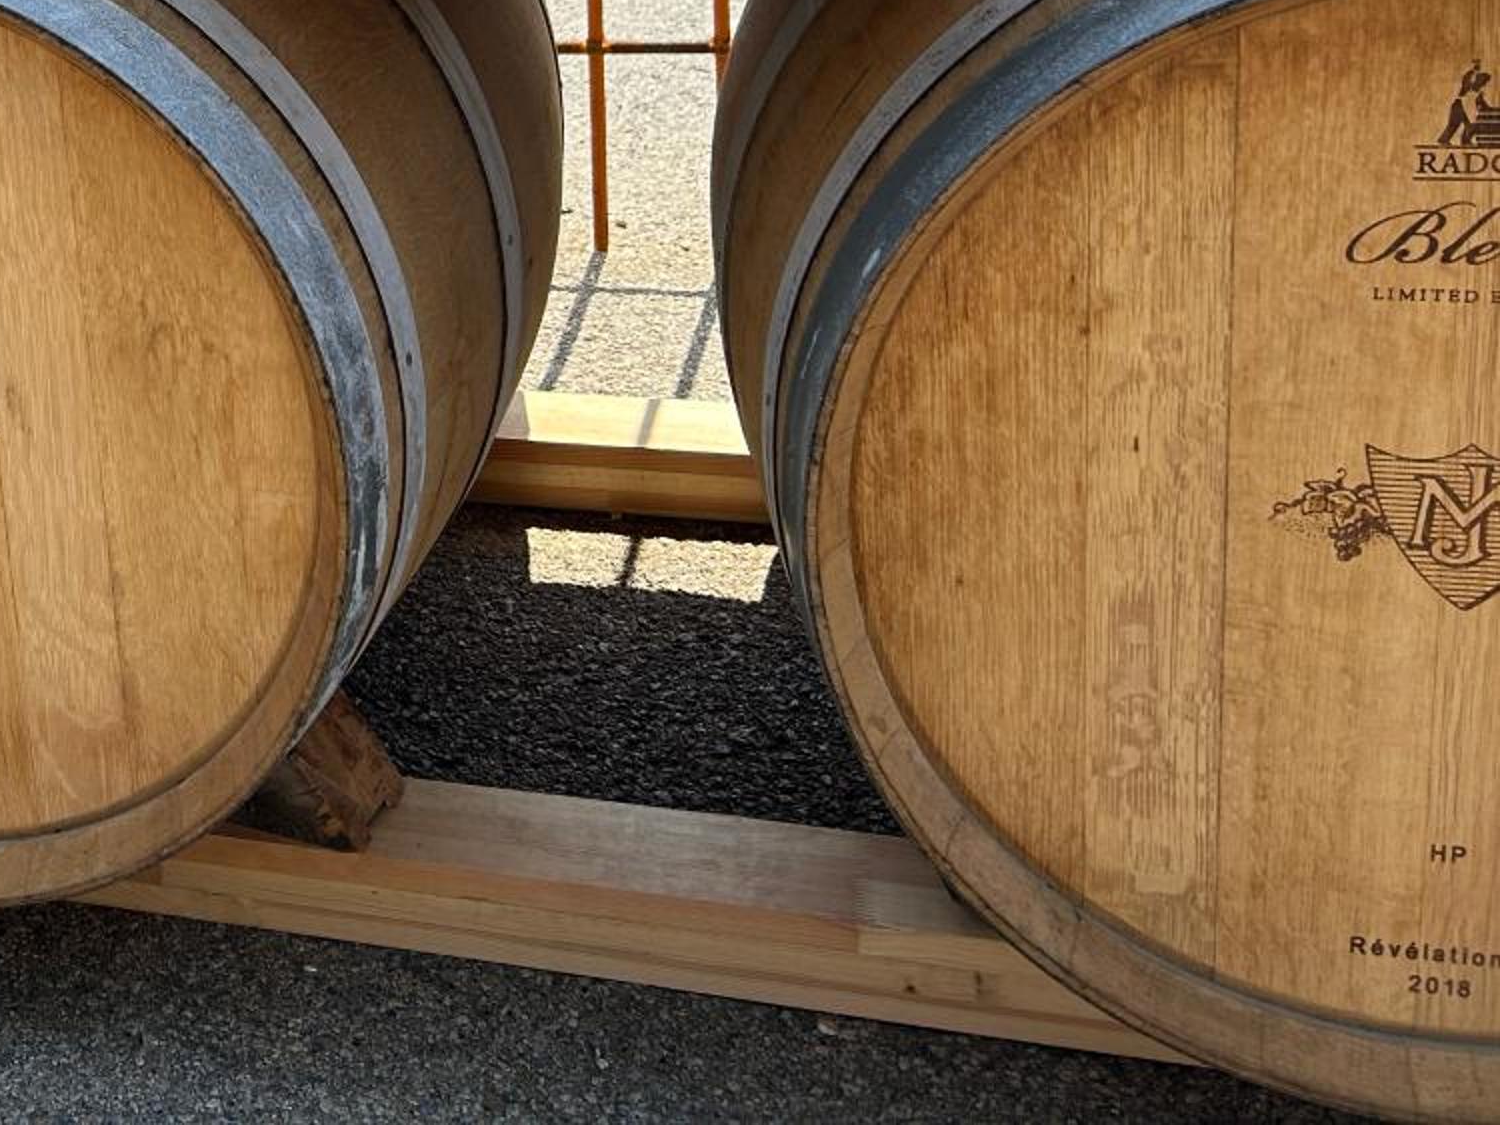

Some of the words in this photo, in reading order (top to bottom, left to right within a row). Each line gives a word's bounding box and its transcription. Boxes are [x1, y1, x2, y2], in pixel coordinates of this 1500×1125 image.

[1373, 287, 1480, 304] LIMITED
[1430, 844, 1467, 863] HP
[1408, 974, 1472, 998] 2018
